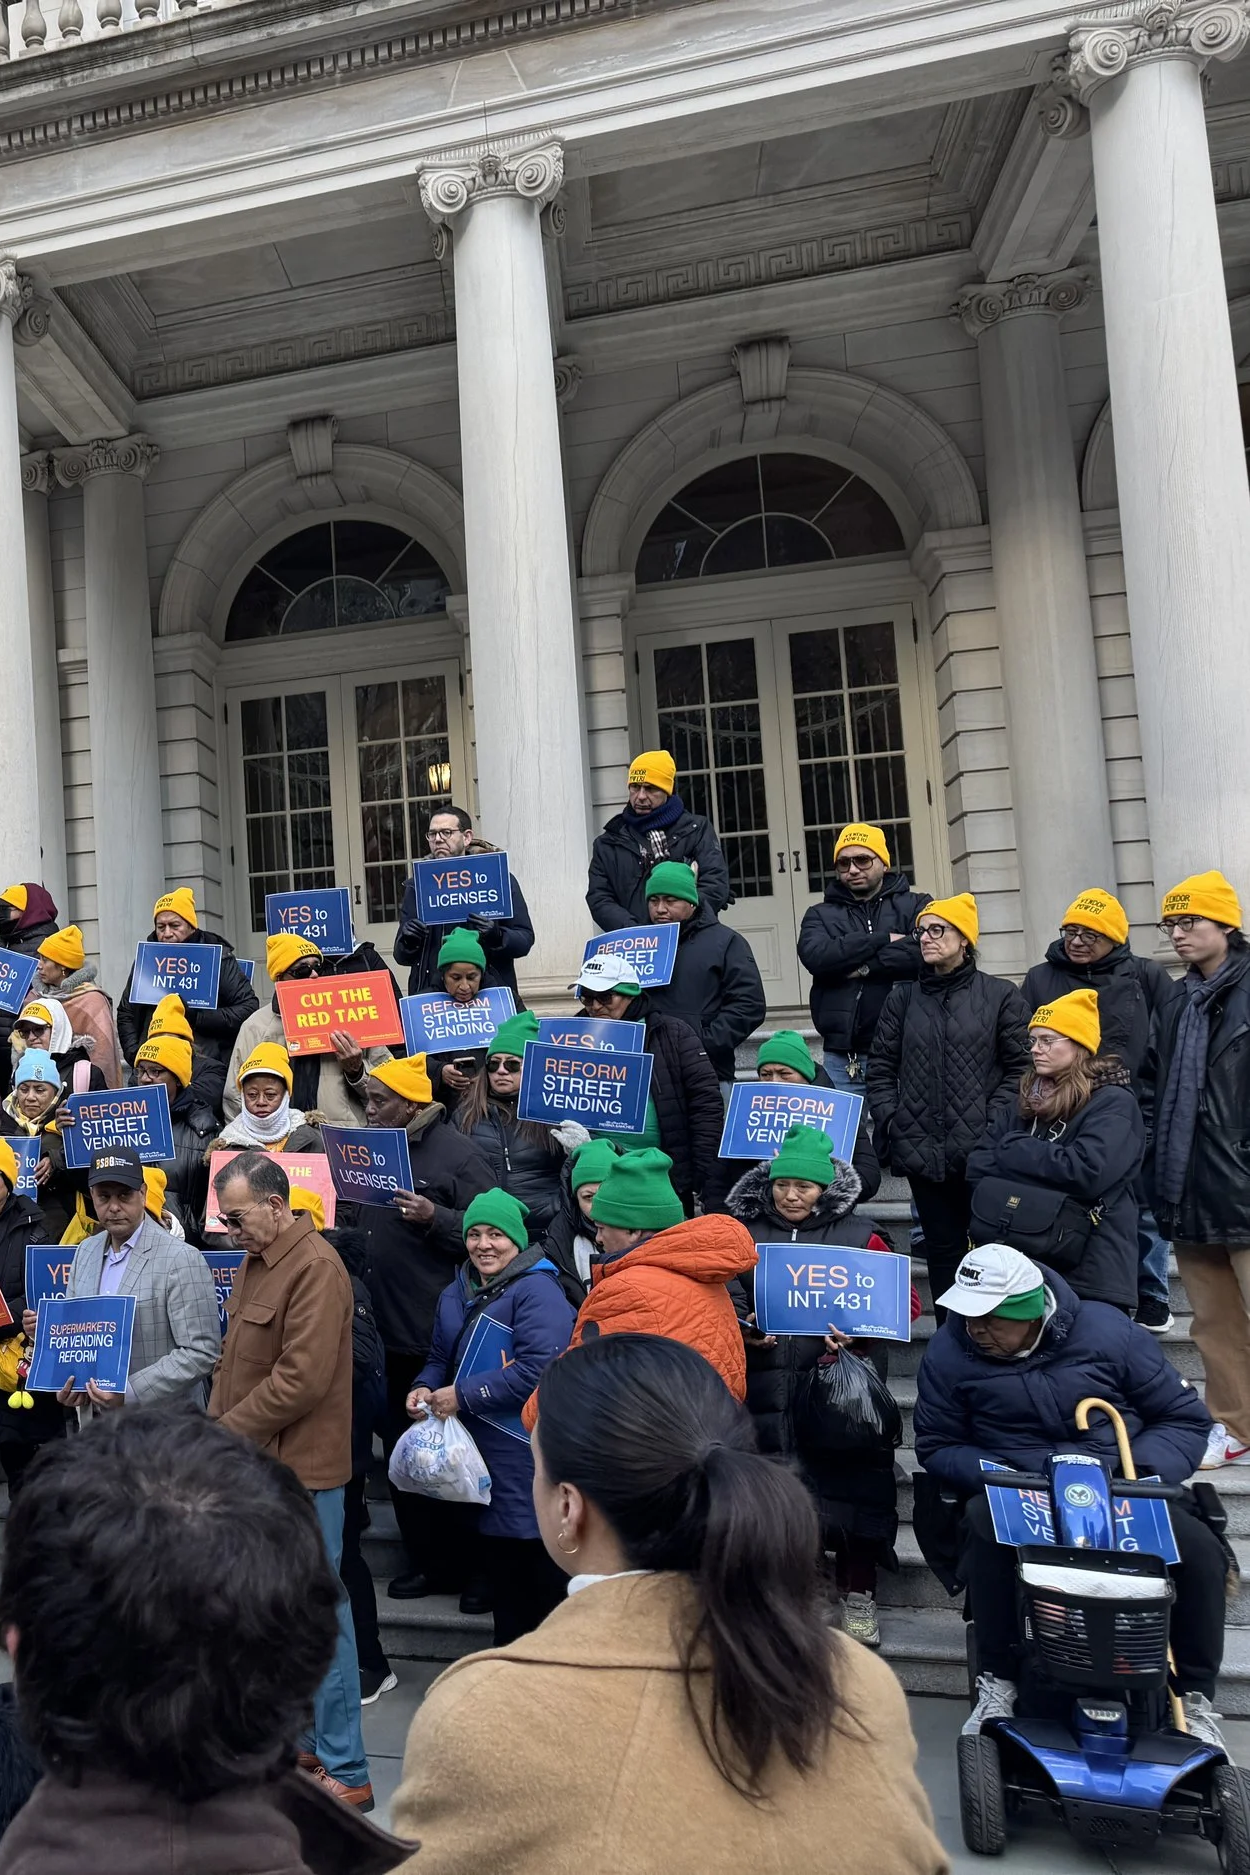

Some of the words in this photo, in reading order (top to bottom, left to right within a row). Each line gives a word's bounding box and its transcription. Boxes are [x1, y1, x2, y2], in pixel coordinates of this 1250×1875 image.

[433, 870, 471, 890] YES
[475, 873, 487, 884] to
[429, 890, 498, 908] LICENSES
[1080, 898, 1107, 909] VENDOR
[1165, 894, 1190, 902] VENDOR
[278, 906, 311, 924] YES
[315, 910, 327, 920] to
[303, 924, 327, 938] 431
[598, 937, 658, 954] REFORM
[9, 968, 17, 979] to
[155, 957, 187, 974] YES
[191, 963, 200, 972] to
[152, 976, 176, 989] INT.
[179, 976, 198, 989] 431
[300, 992, 333, 1007] CUT
[339, 988, 372, 1004] THE
[422, 998, 490, 1015] REFORM
[296, 1012, 330, 1028] RED
[335, 1006, 379, 1023] TAPE
[423, 1008, 491, 1028] STREET
[425, 1024, 495, 1040] VENDING
[600, 1041, 614, 1050] to
[545, 1058, 627, 1080] REFORM
[543, 1075, 626, 1098] STREET
[79, 1100, 147, 1119] REFORM
[542, 1092, 622, 1114] VENDING
[752, 1096, 834, 1116] REFORM
[81, 1115, 148, 1135] STREET
[83, 1133, 150, 1150] VENDING
[26, 1156, 36, 1168] to
[336, 1143, 371, 1167] YES
[372, 1152, 386, 1166] to
[289, 1167, 312, 1177] THE
[339, 1169, 397, 1190] LICENSES
[47, 1264, 70, 1284] YE
[786, 1264, 849, 1288] YES
[856, 1272, 875, 1288] to
[788, 1290, 827, 1308] INT.
[833, 1293, 871, 1311] 431
[50, 1321, 116, 1336] SUPERMARKETS
[50, 1335, 68, 1348] FOR
[70, 1334, 113, 1348] VENDING
[58, 1350, 97, 1363] REFORM
